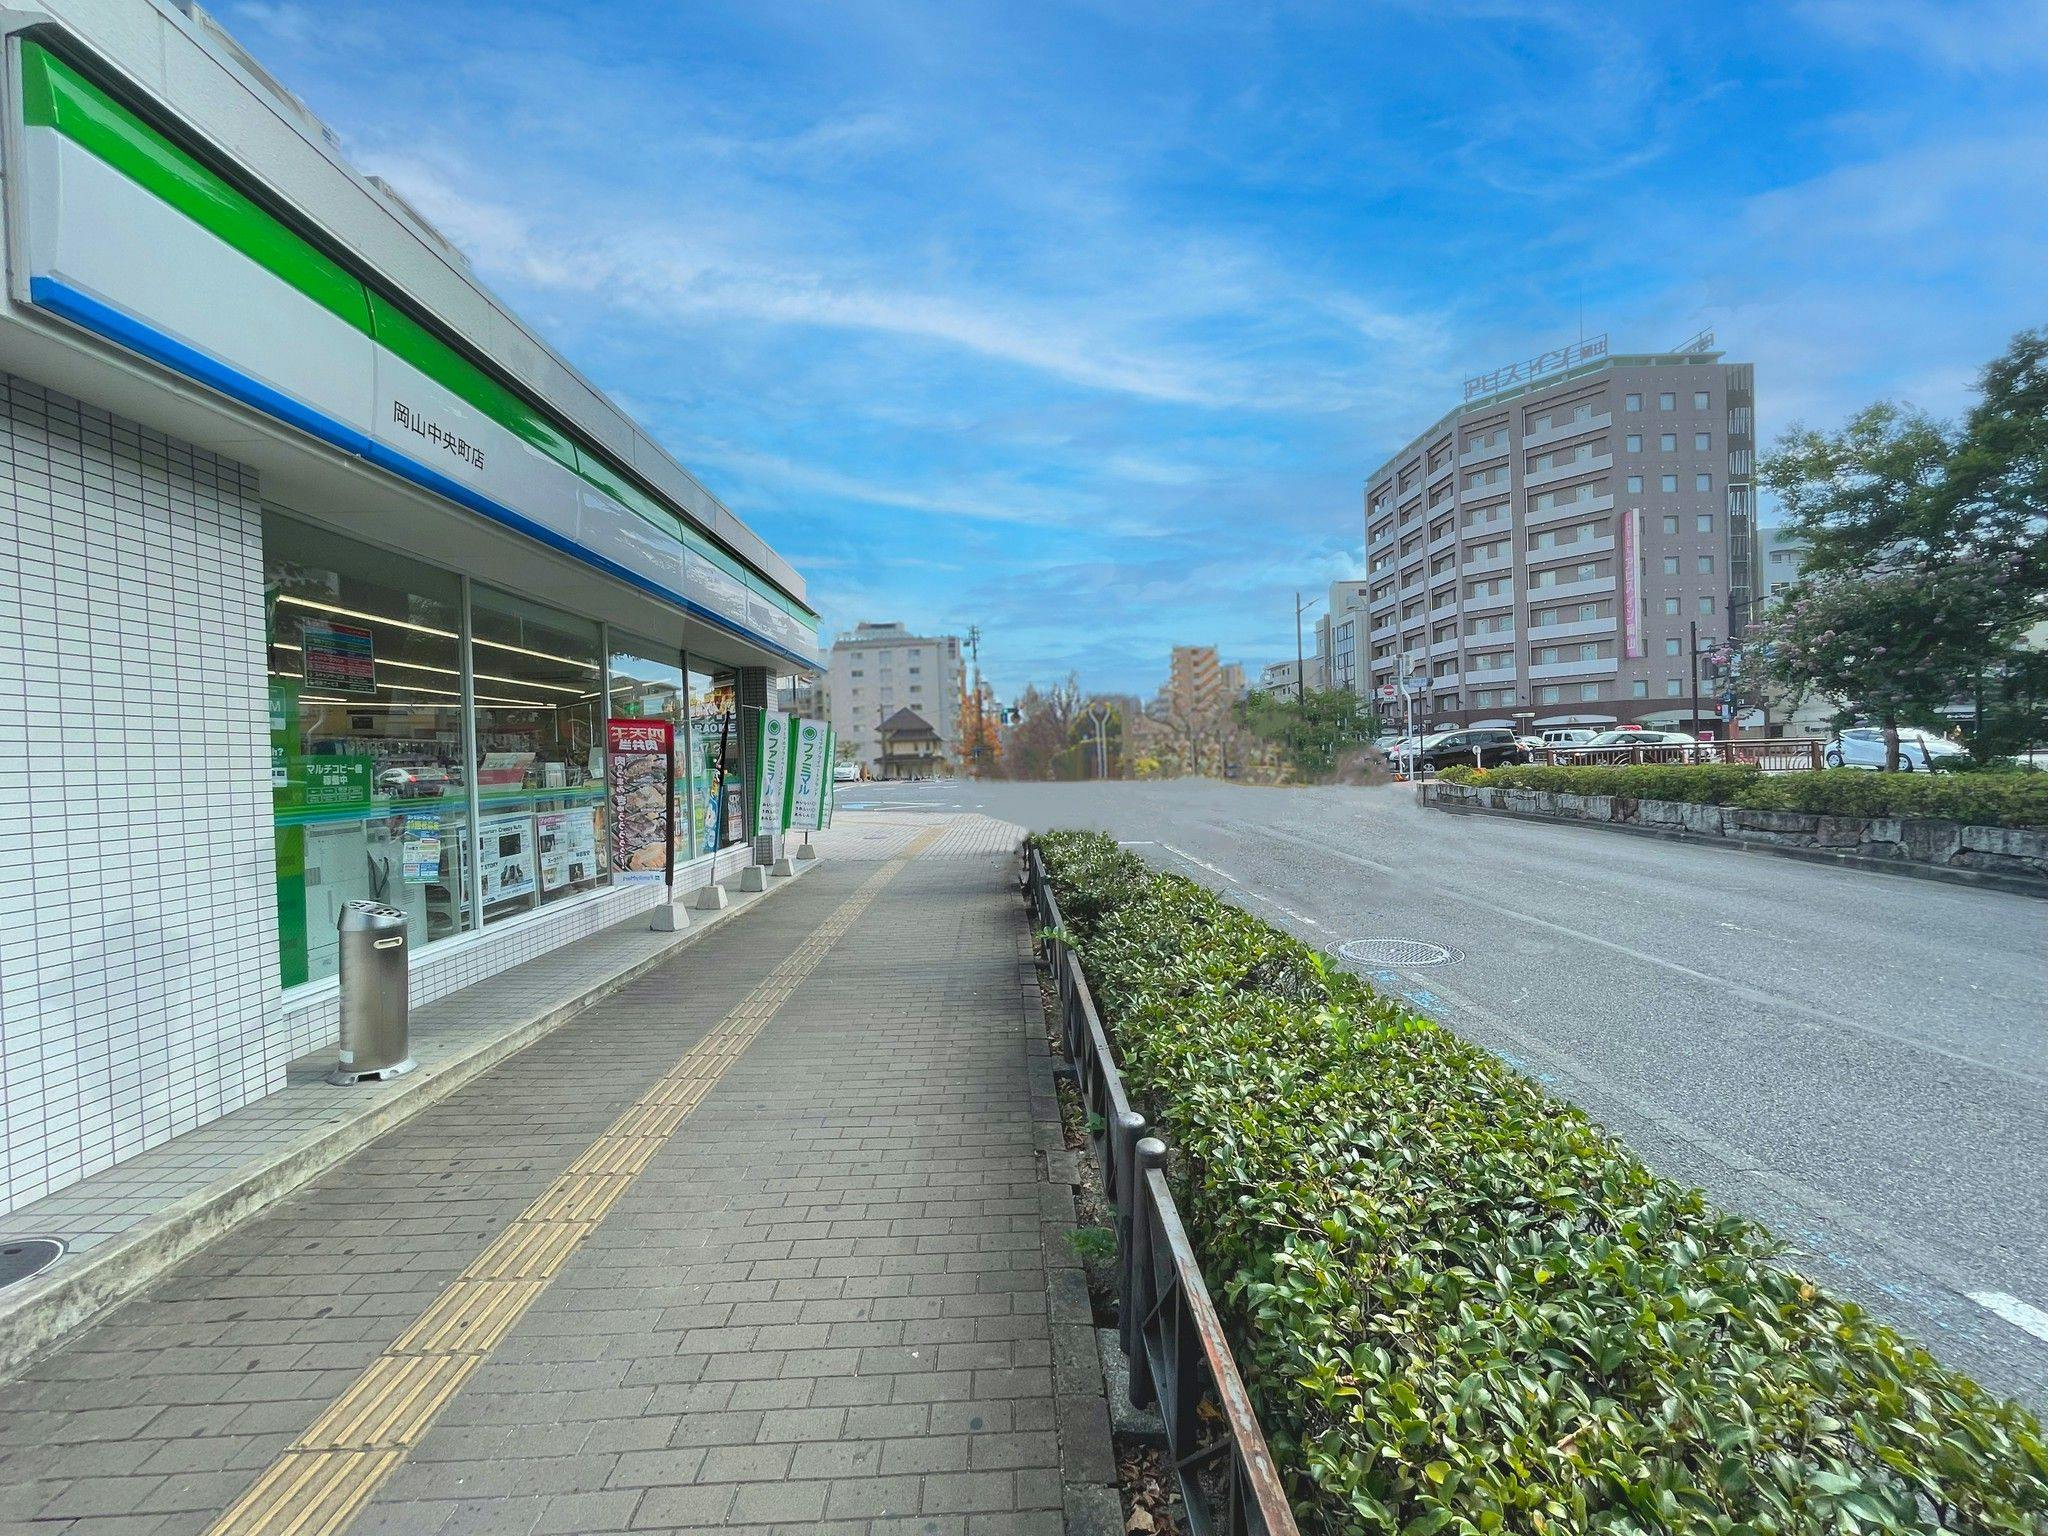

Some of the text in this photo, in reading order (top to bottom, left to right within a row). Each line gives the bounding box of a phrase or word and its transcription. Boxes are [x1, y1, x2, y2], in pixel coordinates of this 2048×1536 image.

[393, 400, 485, 470] 岡山中央町店
[306, 763, 363, 775] マルチコピー機
[798, 742, 813, 796] ファミマル
